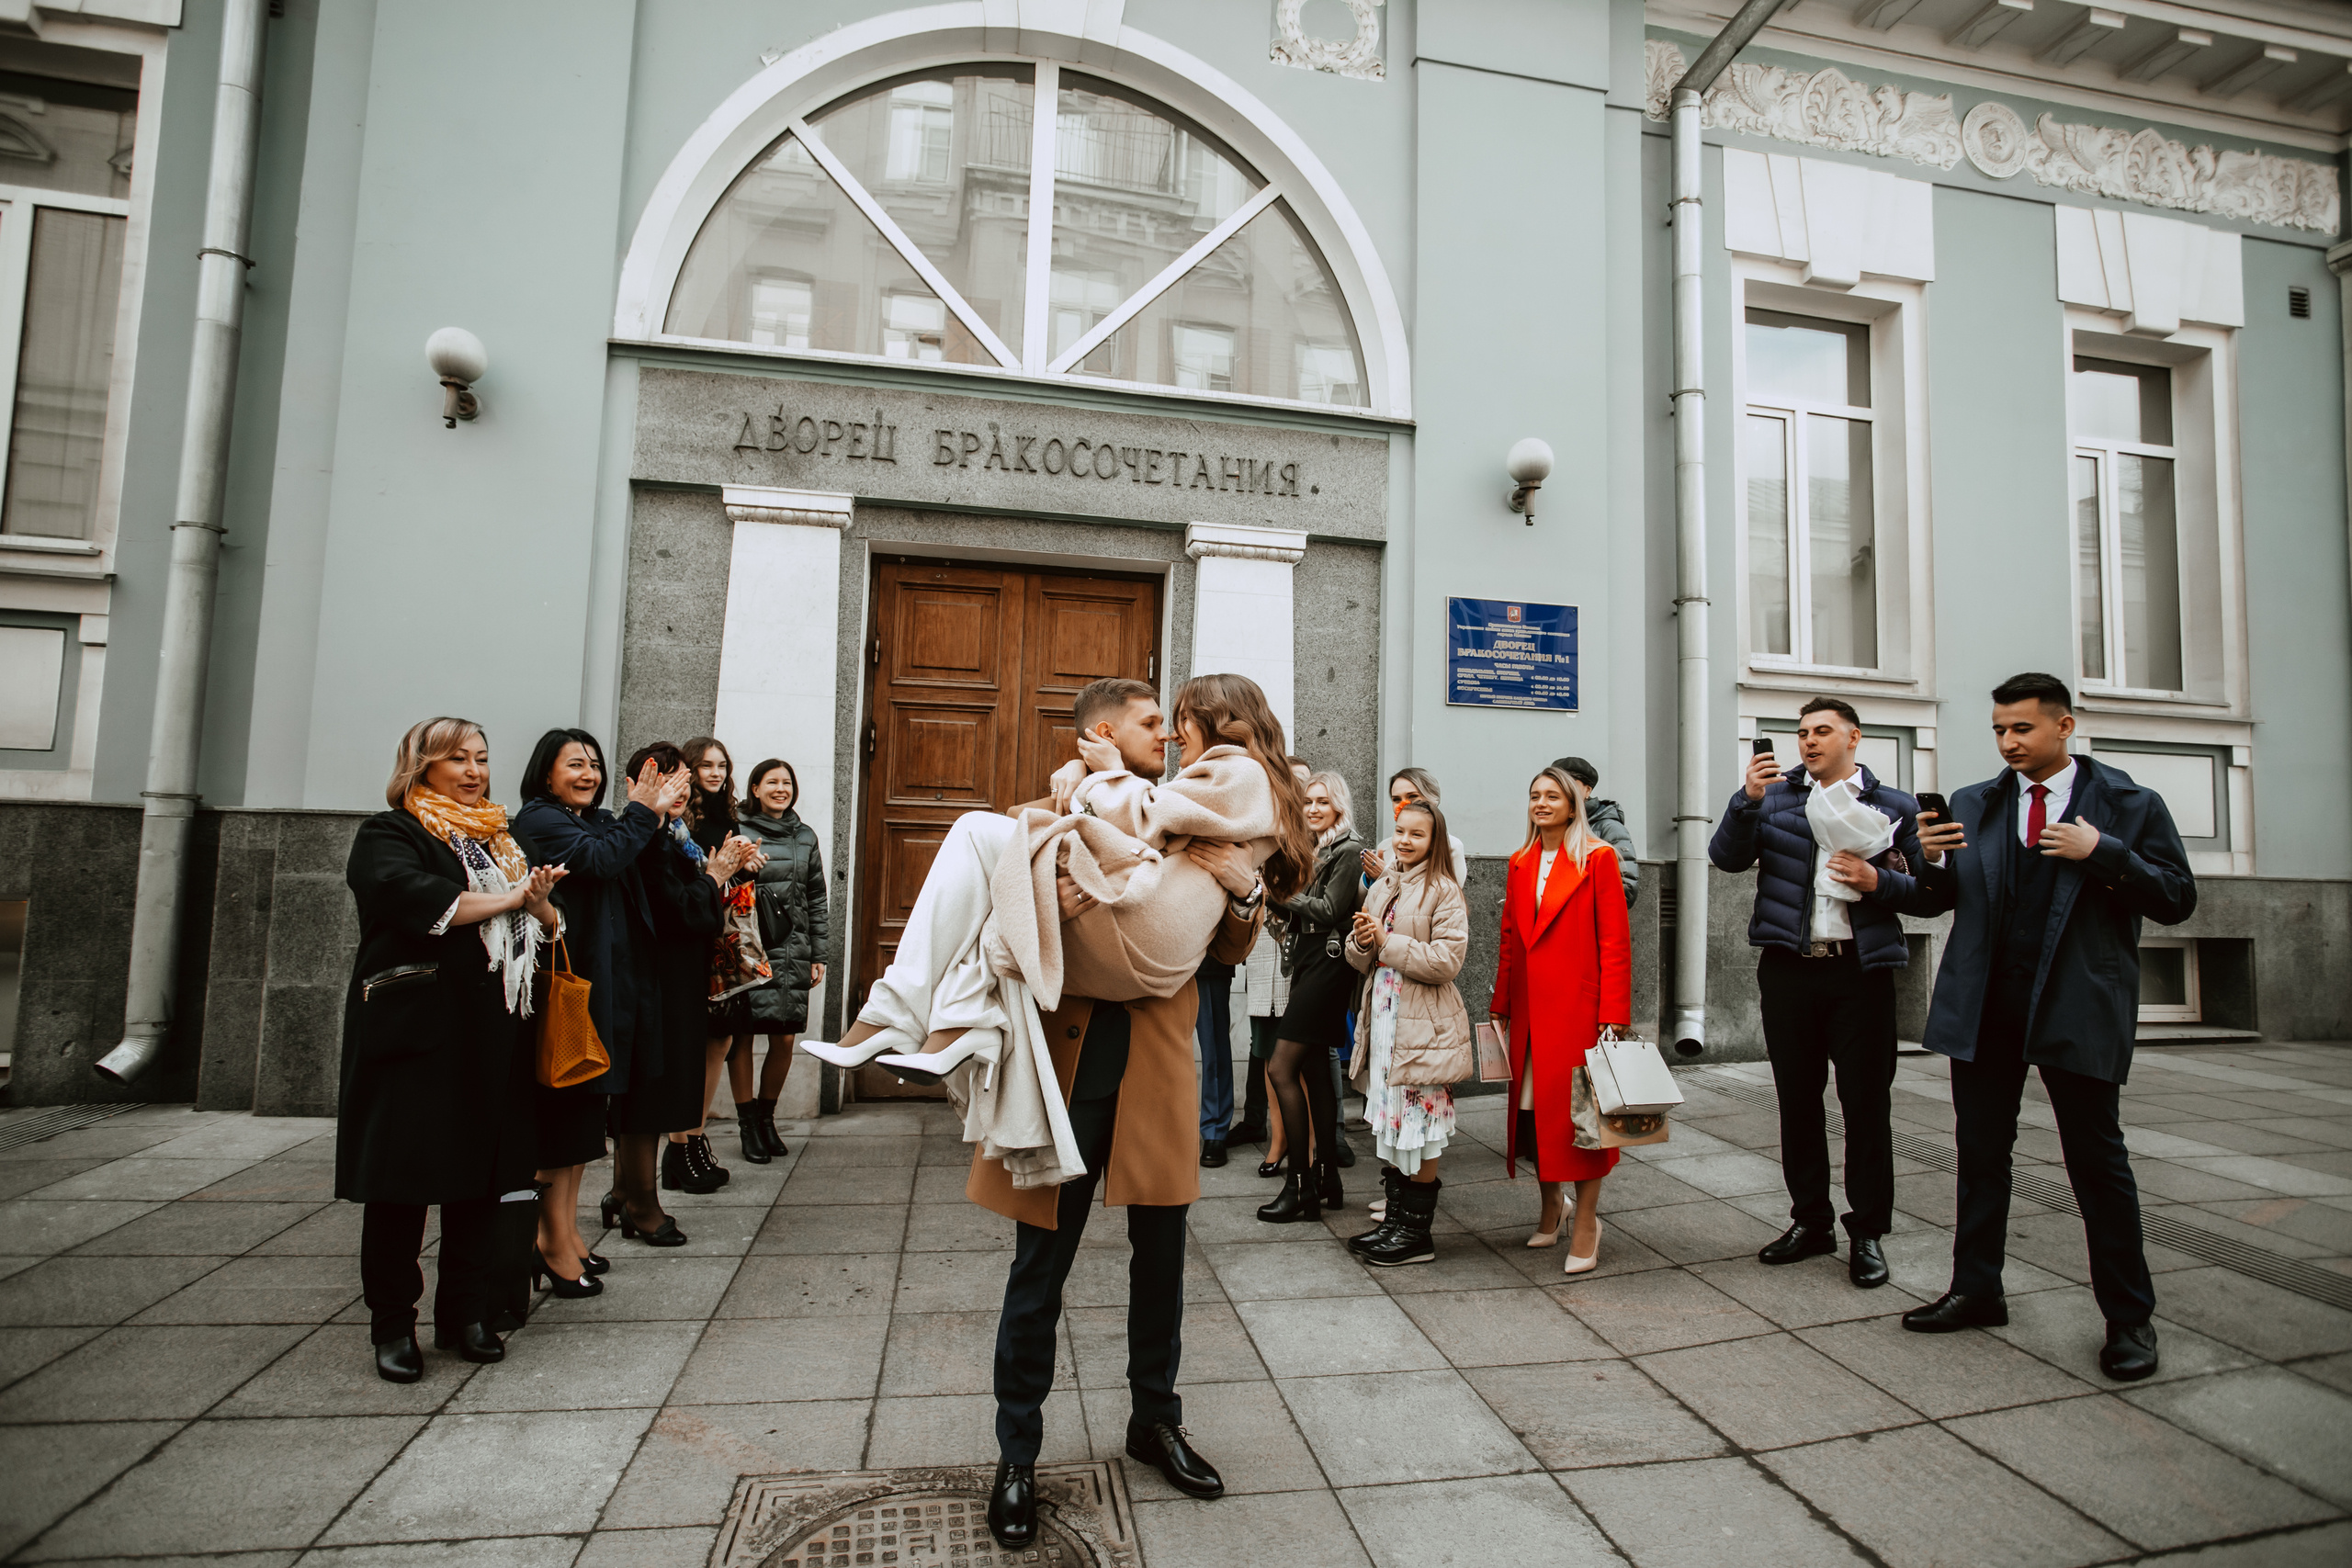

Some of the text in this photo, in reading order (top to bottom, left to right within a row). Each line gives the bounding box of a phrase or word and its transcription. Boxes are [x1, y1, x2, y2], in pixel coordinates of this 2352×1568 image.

[733, 411, 1301, 497] ДВОРЕЦ БРАКОСОЧЕТАНИЯ
[1493, 640, 1535, 651] ДВОРЕЦ
[1457, 648, 1552, 661] БРАКОСОЧЕТАНИЯ
